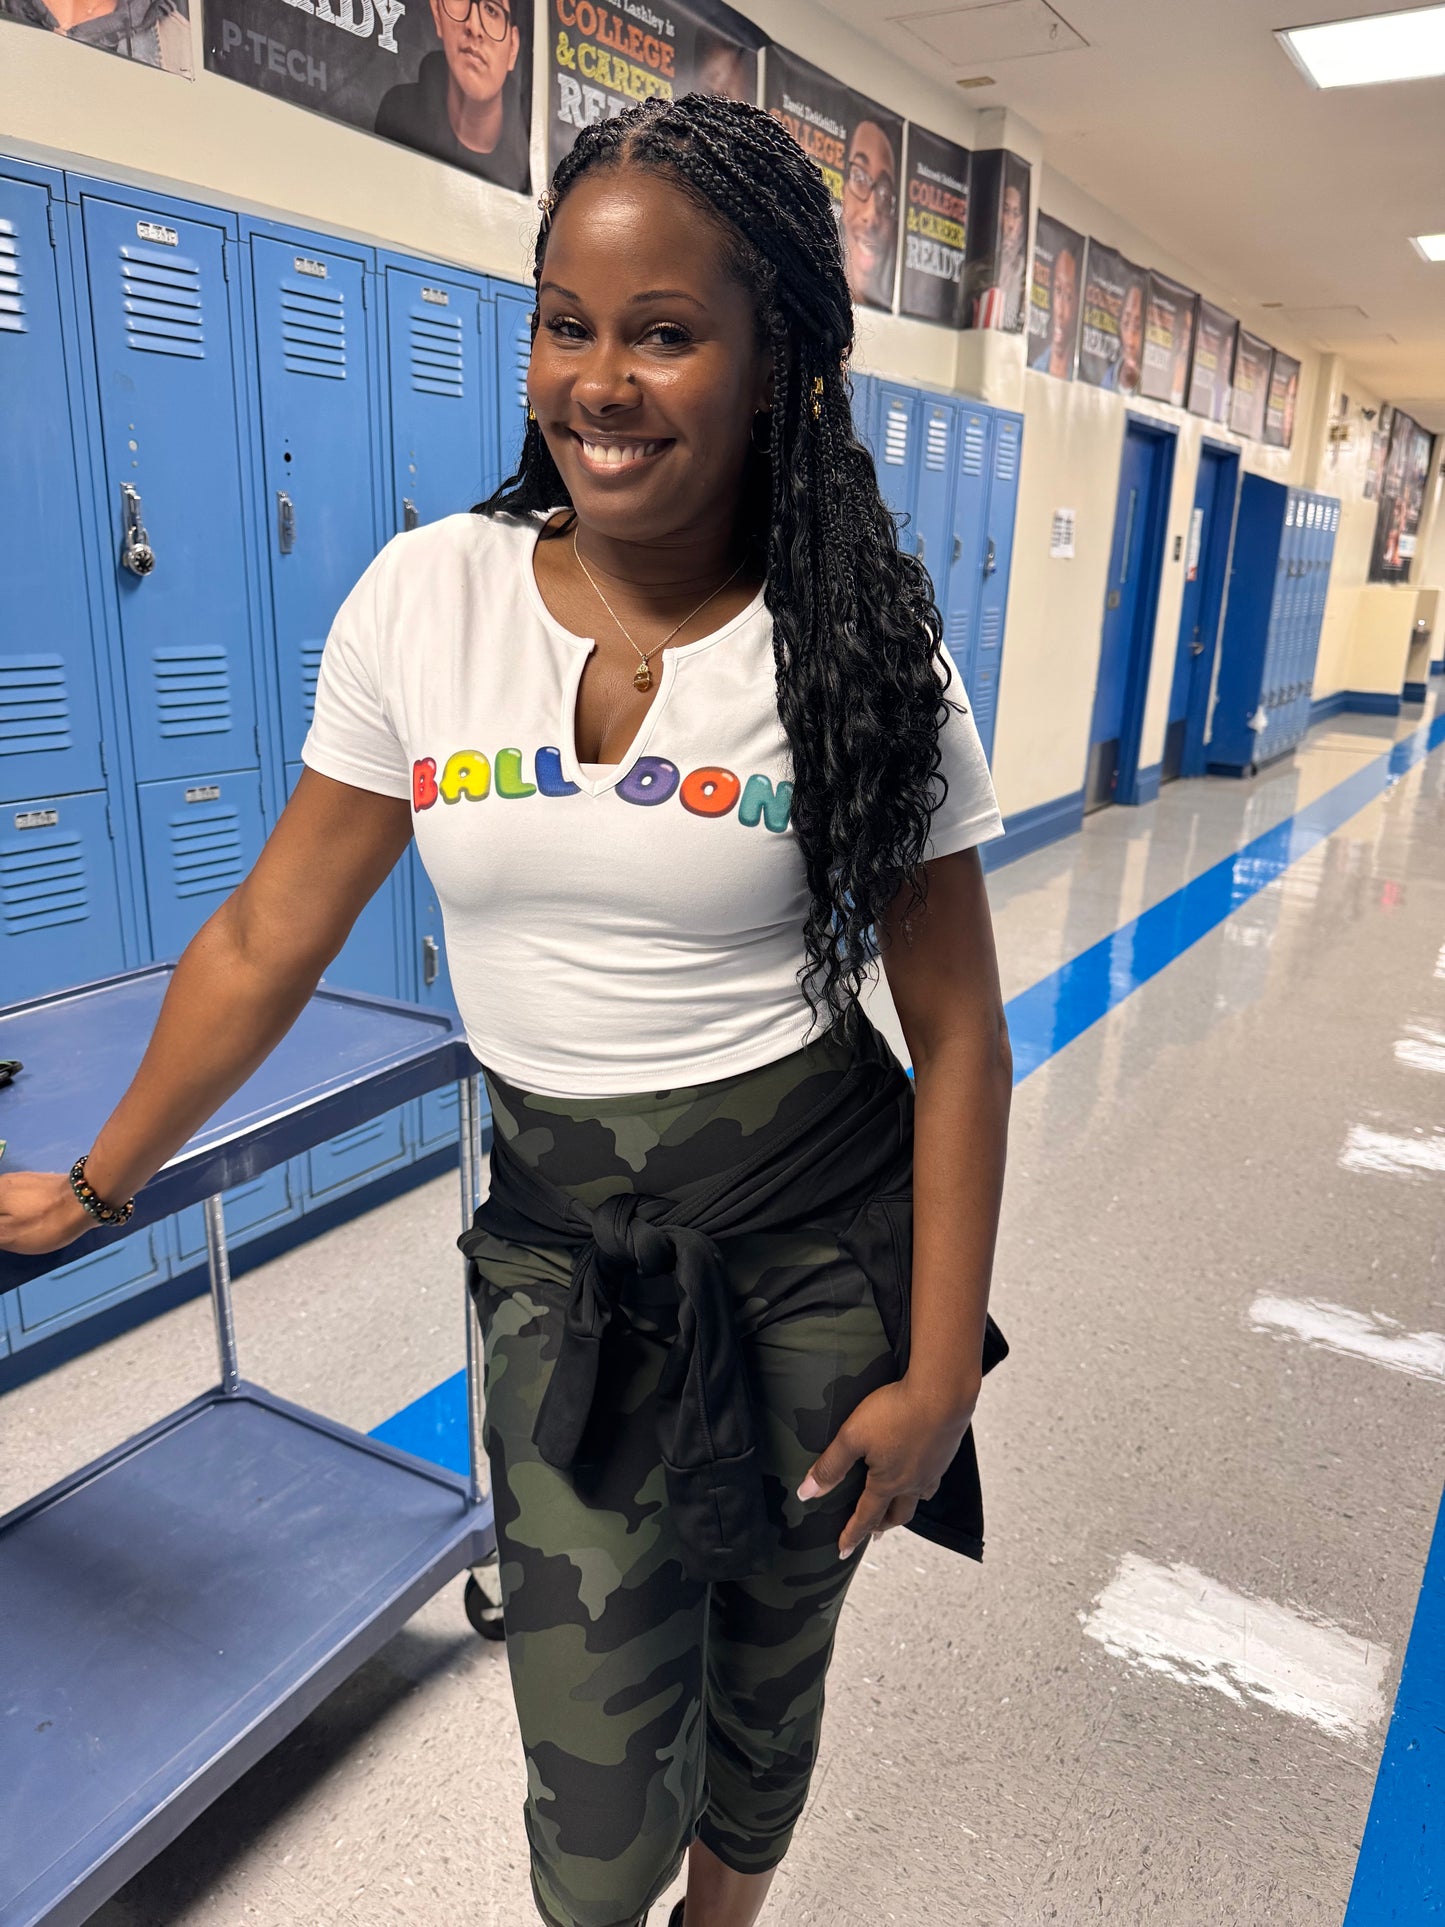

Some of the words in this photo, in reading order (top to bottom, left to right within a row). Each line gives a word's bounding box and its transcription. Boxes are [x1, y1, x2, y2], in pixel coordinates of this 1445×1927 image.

[556, 0, 675, 78] COLLEGE
[556, 31, 576, 71] &
[905, 235, 965, 283] READY
[413, 746, 797, 834] BALLOON
